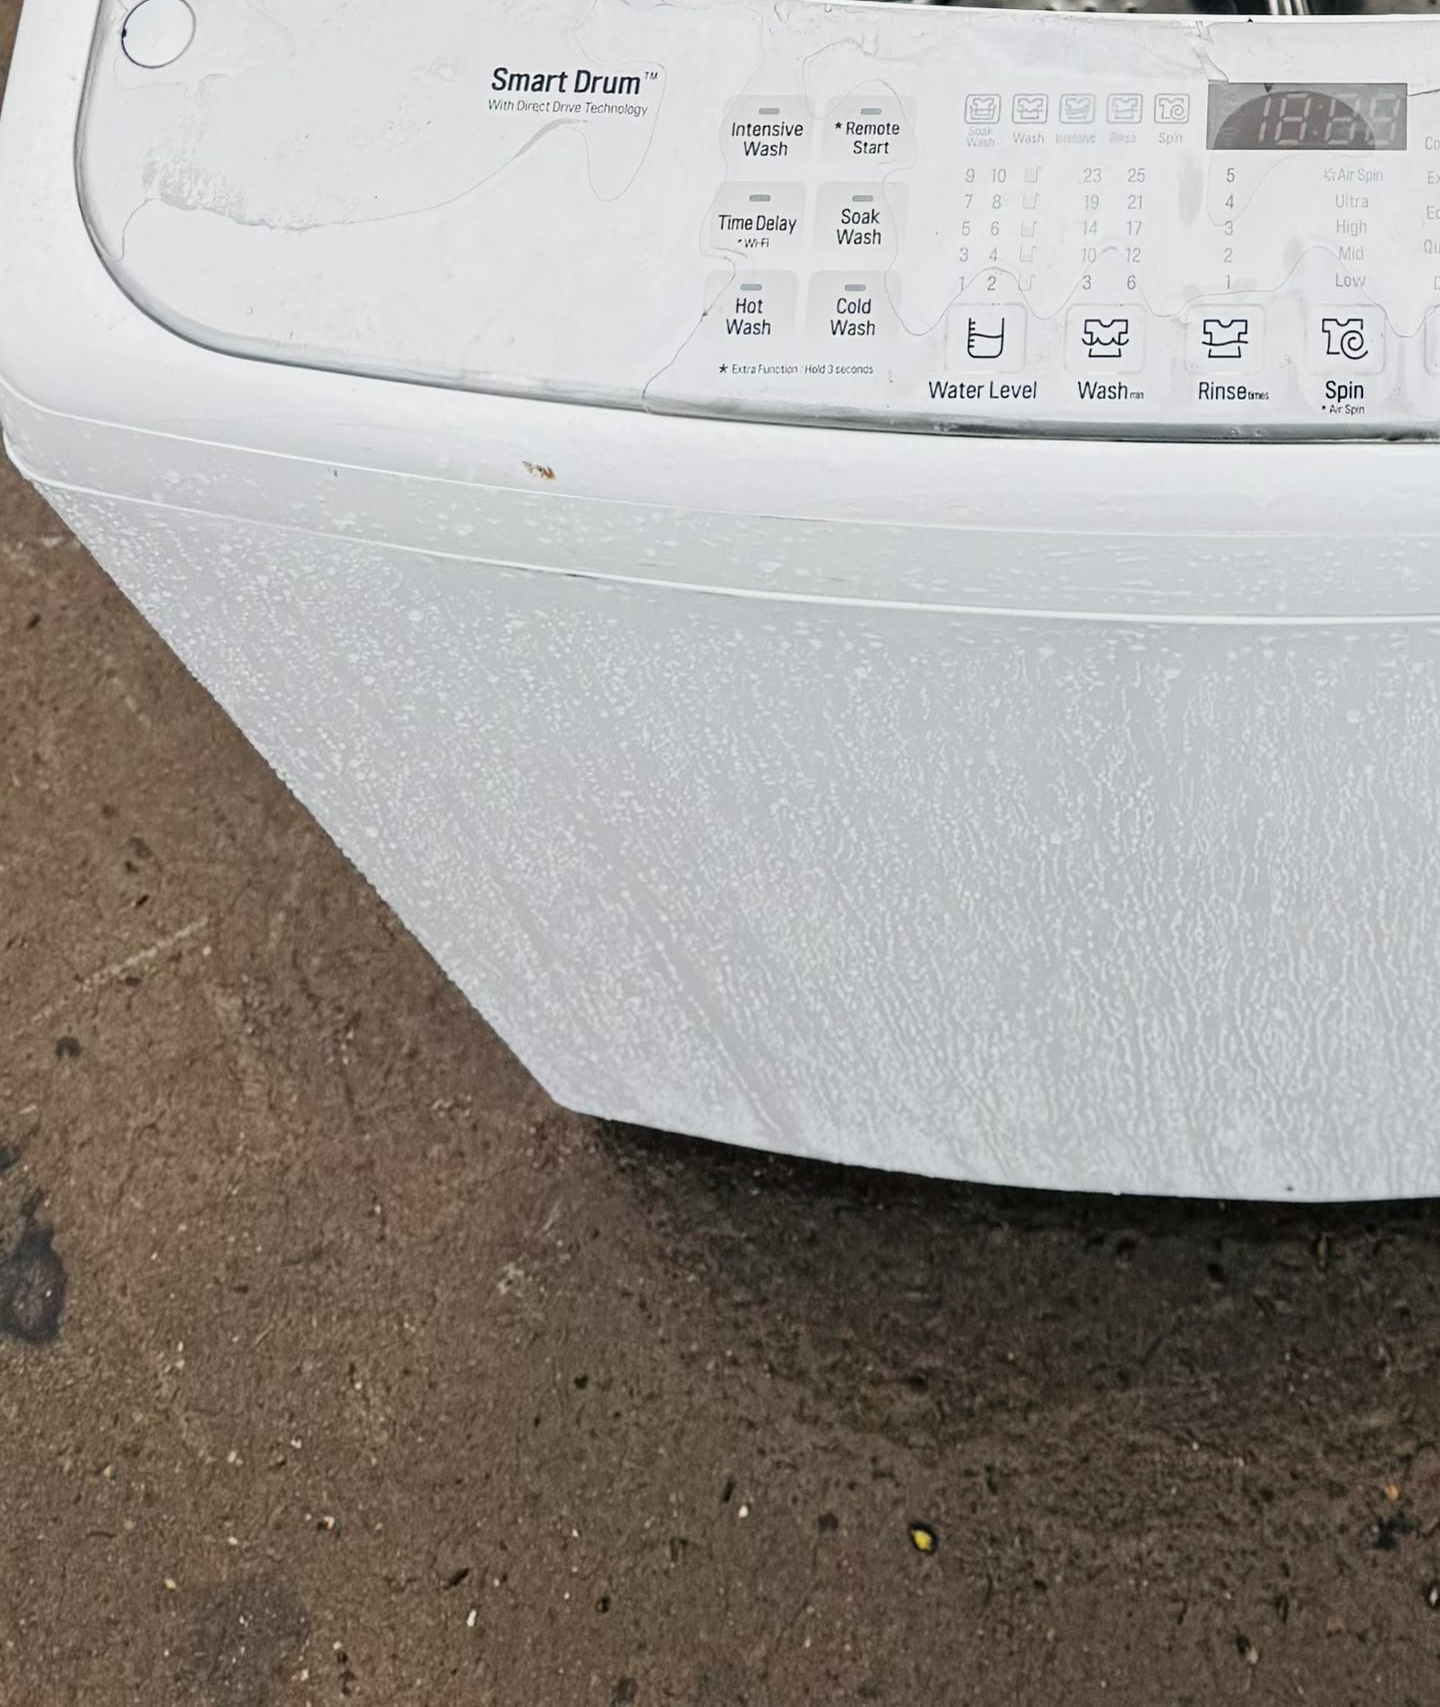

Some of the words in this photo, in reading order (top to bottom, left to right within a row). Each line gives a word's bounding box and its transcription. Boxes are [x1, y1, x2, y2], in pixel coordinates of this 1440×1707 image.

[491, 67, 568, 93] Smart
[488, 99, 514, 111] With
[516, 100, 550, 113] Direct
[552, 101, 581, 113] Drive
[585, 102, 648, 117] Technology
[731, 122, 804, 137] Intensive
[846, 121, 900, 136] Remote
[968, 126, 993, 136] Soak
[966, 137, 995, 147] Wash
[1013, 132, 1045, 144] Wash
[1159, 132, 1183, 145] Spin
[743, 141, 788, 157] Wash
[853, 140, 889, 154] Start
[965, 168, 975, 183] 9
[992, 168, 1007, 183] 10
[1083, 168, 1102, 183] 23
[1127, 168, 1146, 183] 25
[1226, 168, 1235, 182] 5
[1337, 168, 1355, 181] Air
[1358, 168, 1383, 184] Spin
[964, 194, 973, 209] 7
[992, 194, 1001, 209] 8
[1085, 195, 1100, 210] 19
[1127, 194, 1143, 210] 21
[1225, 194, 1234, 209] 4
[1335, 194, 1369, 208] Ultra
[841, 209, 880, 224] Soak
[718, 215, 753, 230] Time
[755, 215, 797, 235] Delay
[961, 221, 971, 236] 5
[990, 221, 1000, 236] 6
[1082, 221, 1098, 235] 14
[1126, 221, 1142, 236] 17
[1224, 220, 1234, 235] 3
[1336, 219, 1367, 236] High
[836, 229, 882, 245] Wash
[959, 247, 969, 262] 3
[989, 247, 998, 262] 4
[1081, 247, 1097, 263] 10
[1126, 247, 1141, 263] 12
[1224, 248, 1233, 263] 2
[1338, 246, 1364, 260] Mid
[959, 276, 965, 291] 1
[987, 276, 997, 291] 2
[1082, 275, 1092, 290] 3
[1126, 275, 1136, 290] 6
[1335, 272, 1366, 287] Low
[735, 298, 763, 314] Hot
[836, 298, 872, 314] Cold
[726, 319, 771, 335] Wash
[830, 319, 876, 336] Wash
[731, 363, 757, 374] Extra
[758, 363, 799, 375] Function
[804, 364, 825, 374] Hold
[827, 364, 834, 374] 3
[835, 364, 874, 374] seconds
[929, 381, 984, 399] Water
[989, 381, 1037, 399] Level
[1078, 381, 1128, 400] Wash
[1198, 381, 1247, 400] Rinse
[1325, 380, 1365, 403] Spin
[1329, 405, 1343, 414] Air
[1345, 404, 1365, 416] Spin
